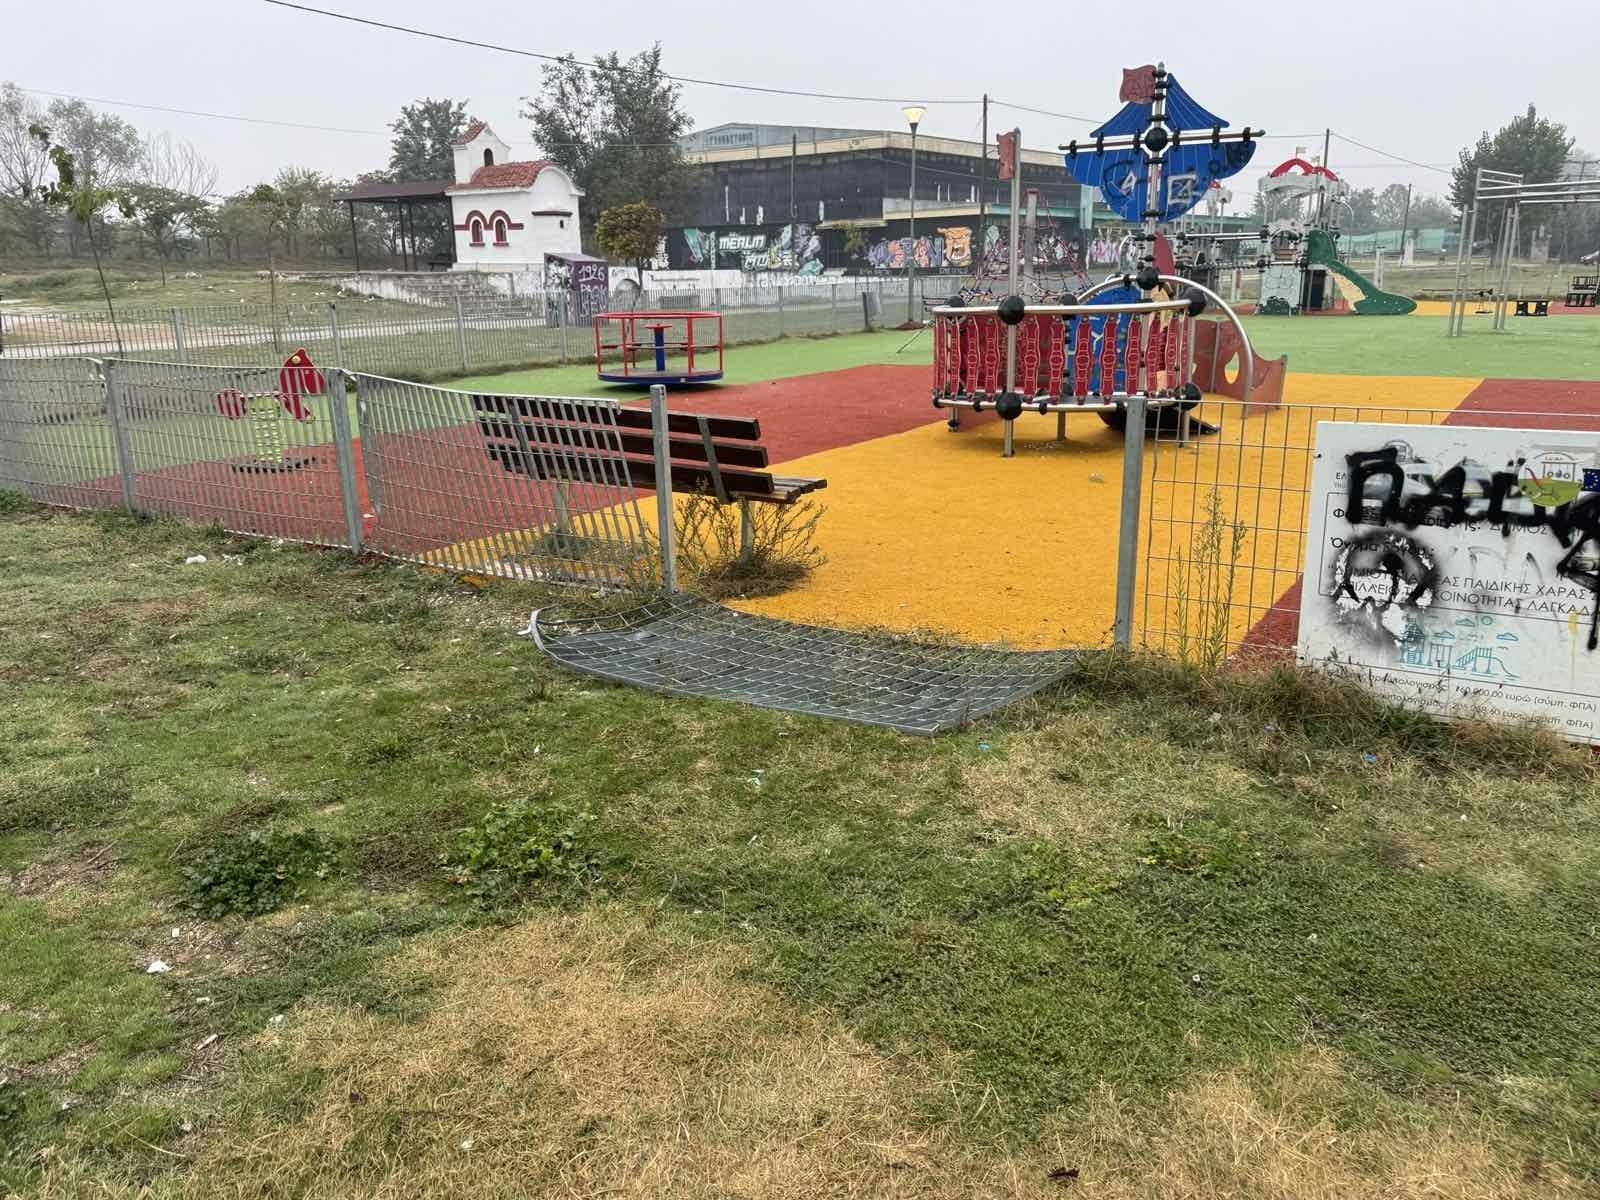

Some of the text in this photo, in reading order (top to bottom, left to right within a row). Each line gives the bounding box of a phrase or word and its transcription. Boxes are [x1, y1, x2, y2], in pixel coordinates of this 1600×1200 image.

[1463, 577, 1531, 594] ΠΑΙΔΙΚΗΣ
[1536, 583, 1586, 600] ΧΑΡΑΣ
[1569, 701, 1597, 713] ΦΠΑ)
